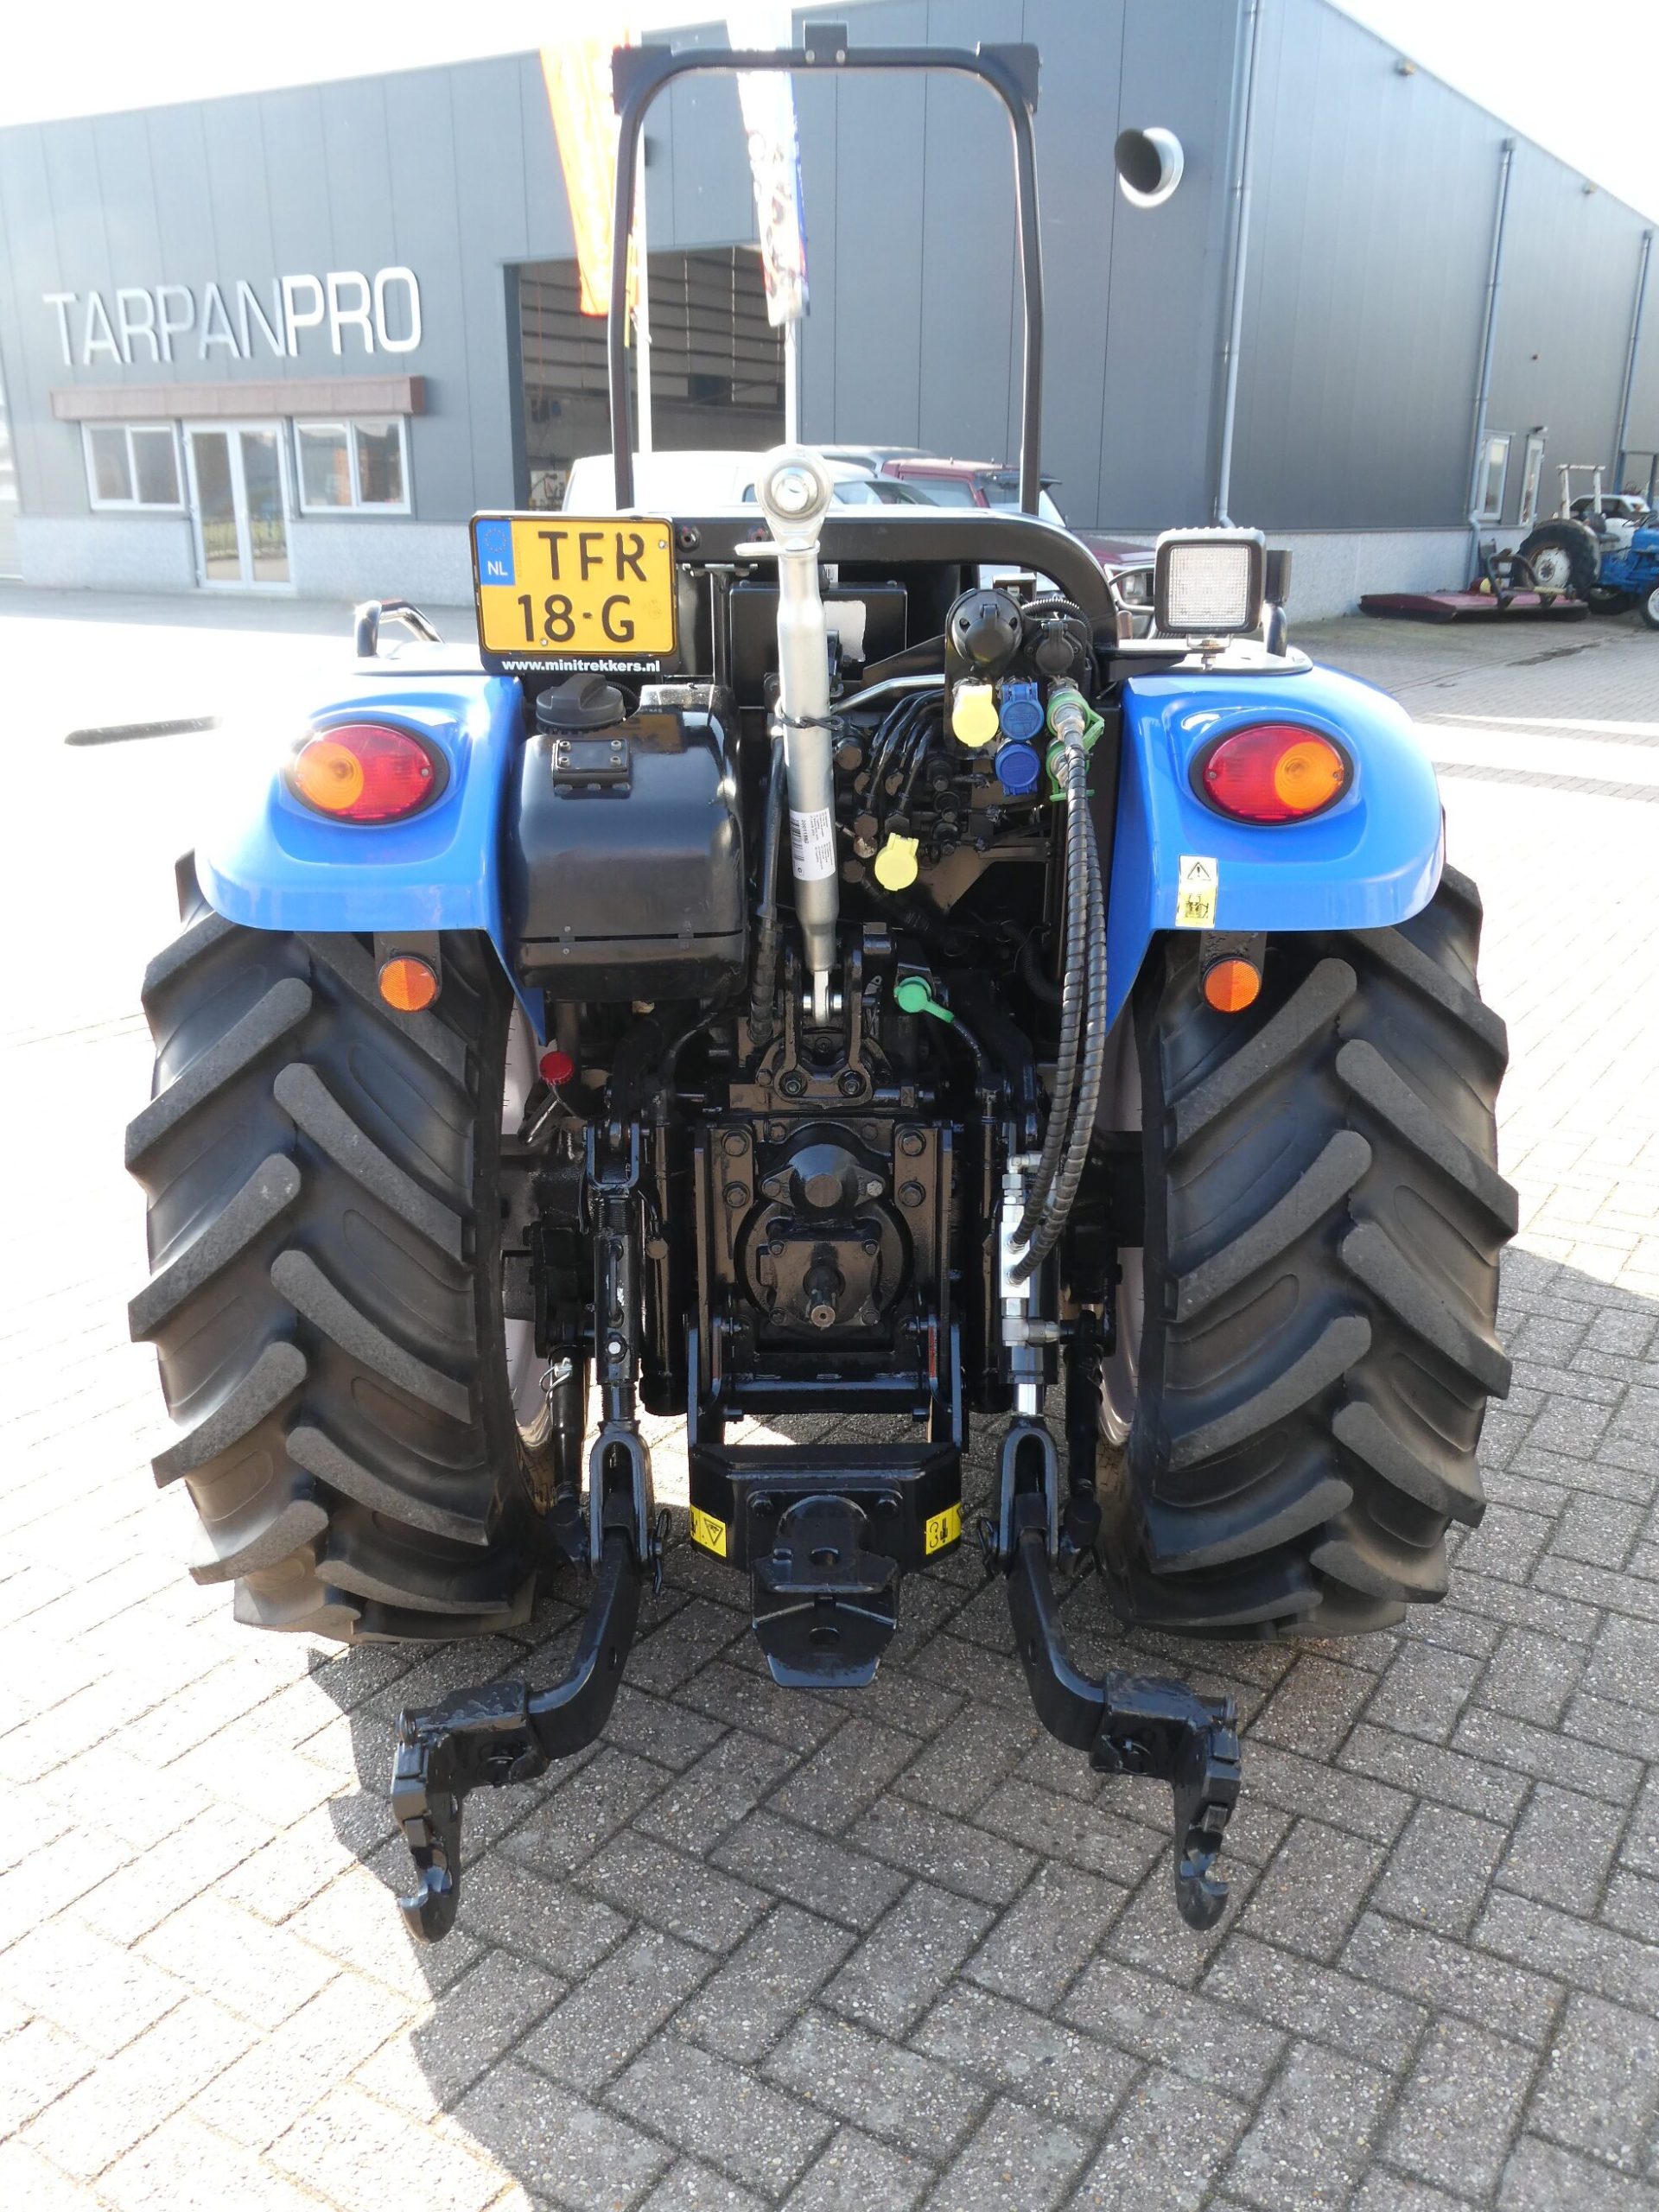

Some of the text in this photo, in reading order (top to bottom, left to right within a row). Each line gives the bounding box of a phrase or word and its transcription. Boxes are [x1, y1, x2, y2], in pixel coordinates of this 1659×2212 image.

[42, 265, 423, 366] TARPANPRO
[487, 560, 508, 576] NL
[537, 531, 647, 582] TFR
[518, 594, 635, 643] 18-G
[501, 658, 661, 672] www.minitrekkers.nl
